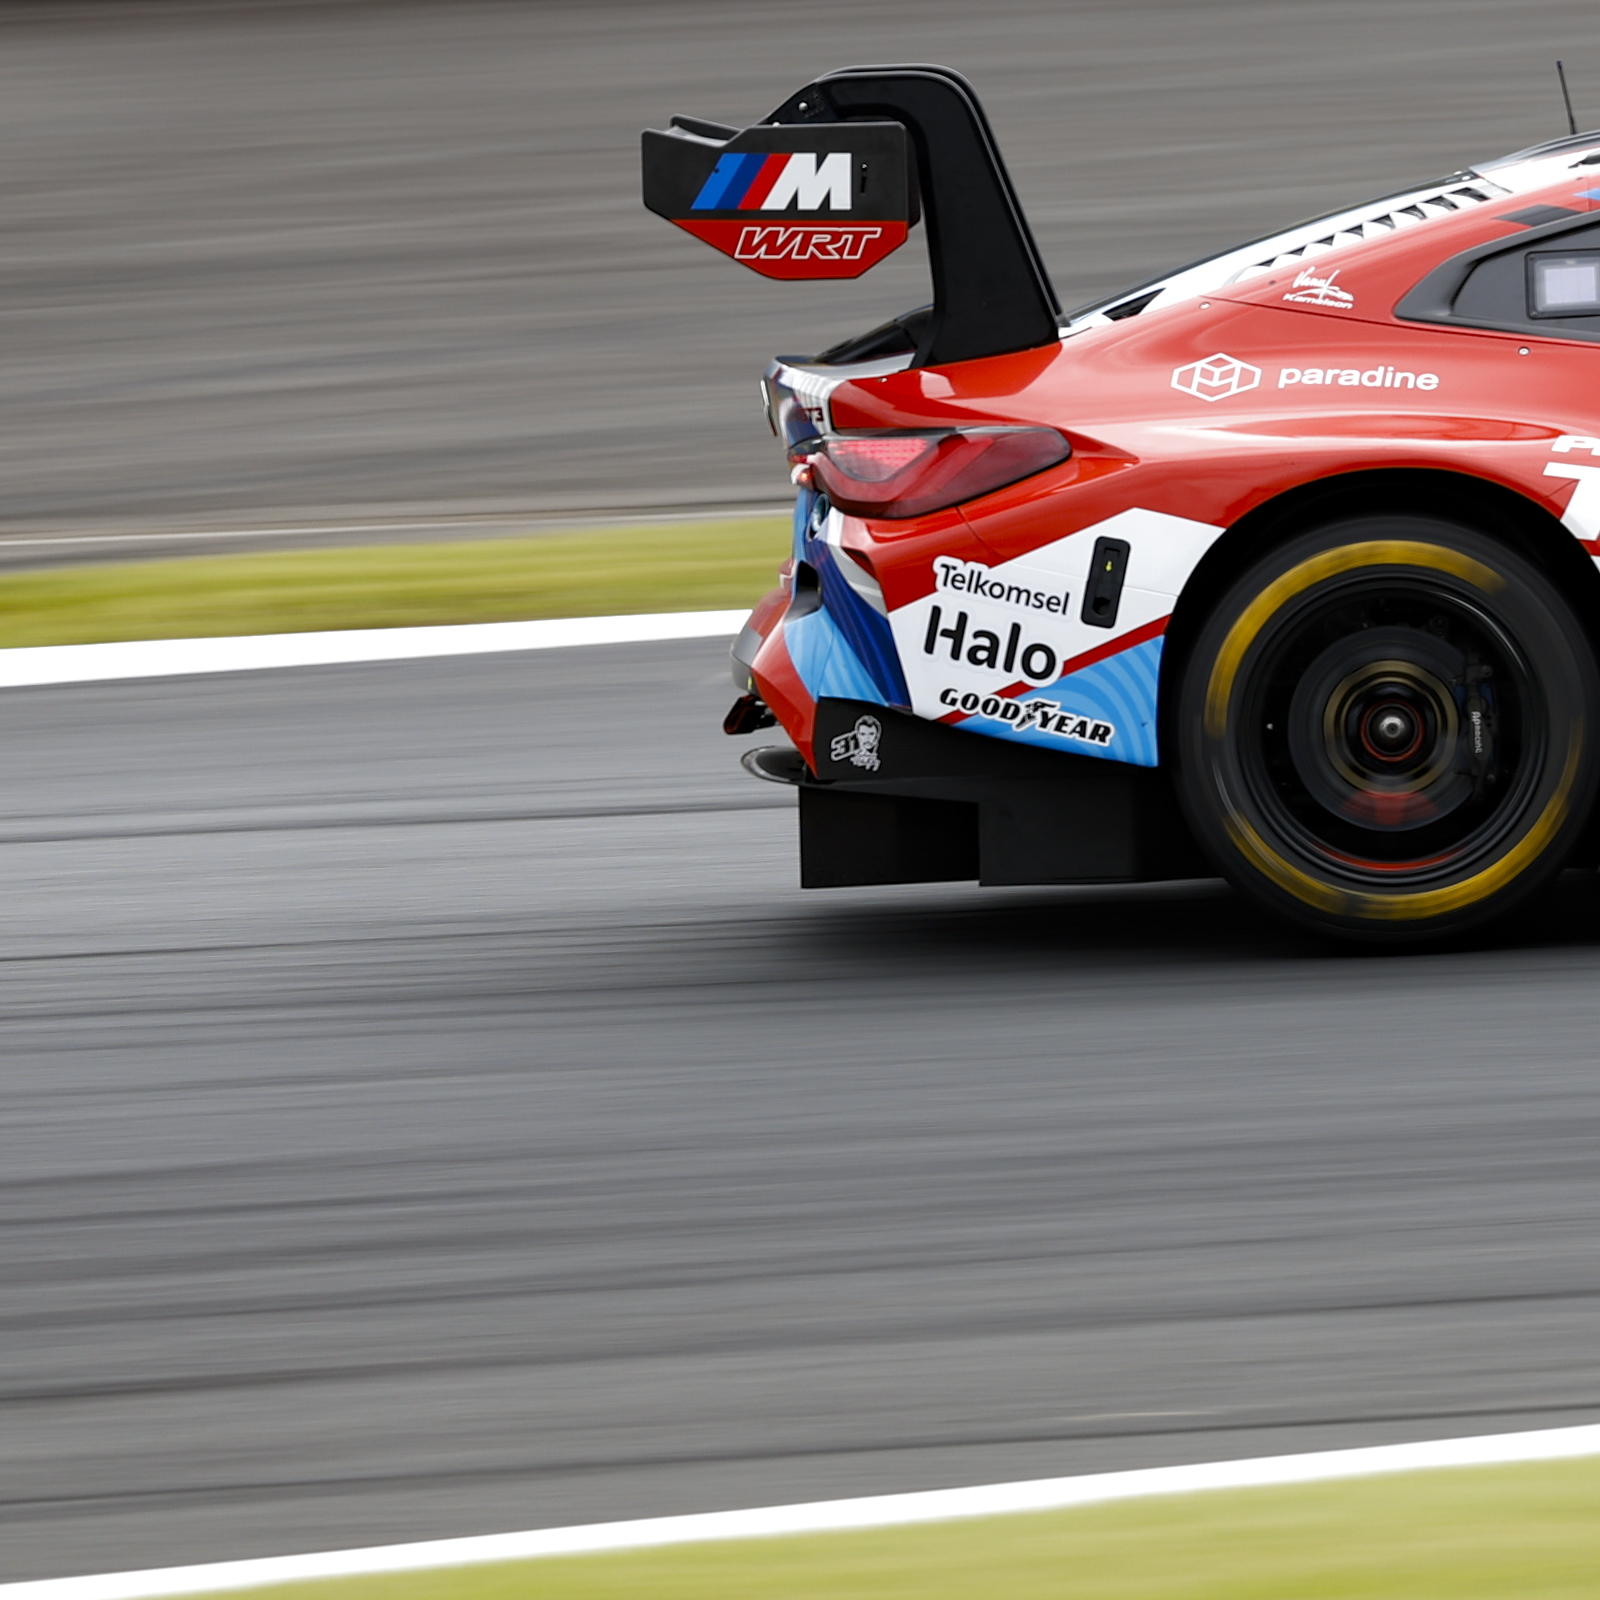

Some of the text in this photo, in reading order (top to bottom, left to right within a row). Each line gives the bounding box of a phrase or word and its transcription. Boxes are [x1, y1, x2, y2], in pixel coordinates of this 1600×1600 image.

[734, 227, 881, 260] WRT
[1278, 365, 1440, 391] paradine
[939, 564, 1071, 616] Telkomsel
[923, 605, 1058, 682] Halo
[940, 687, 1113, 745] GOODYEAR
